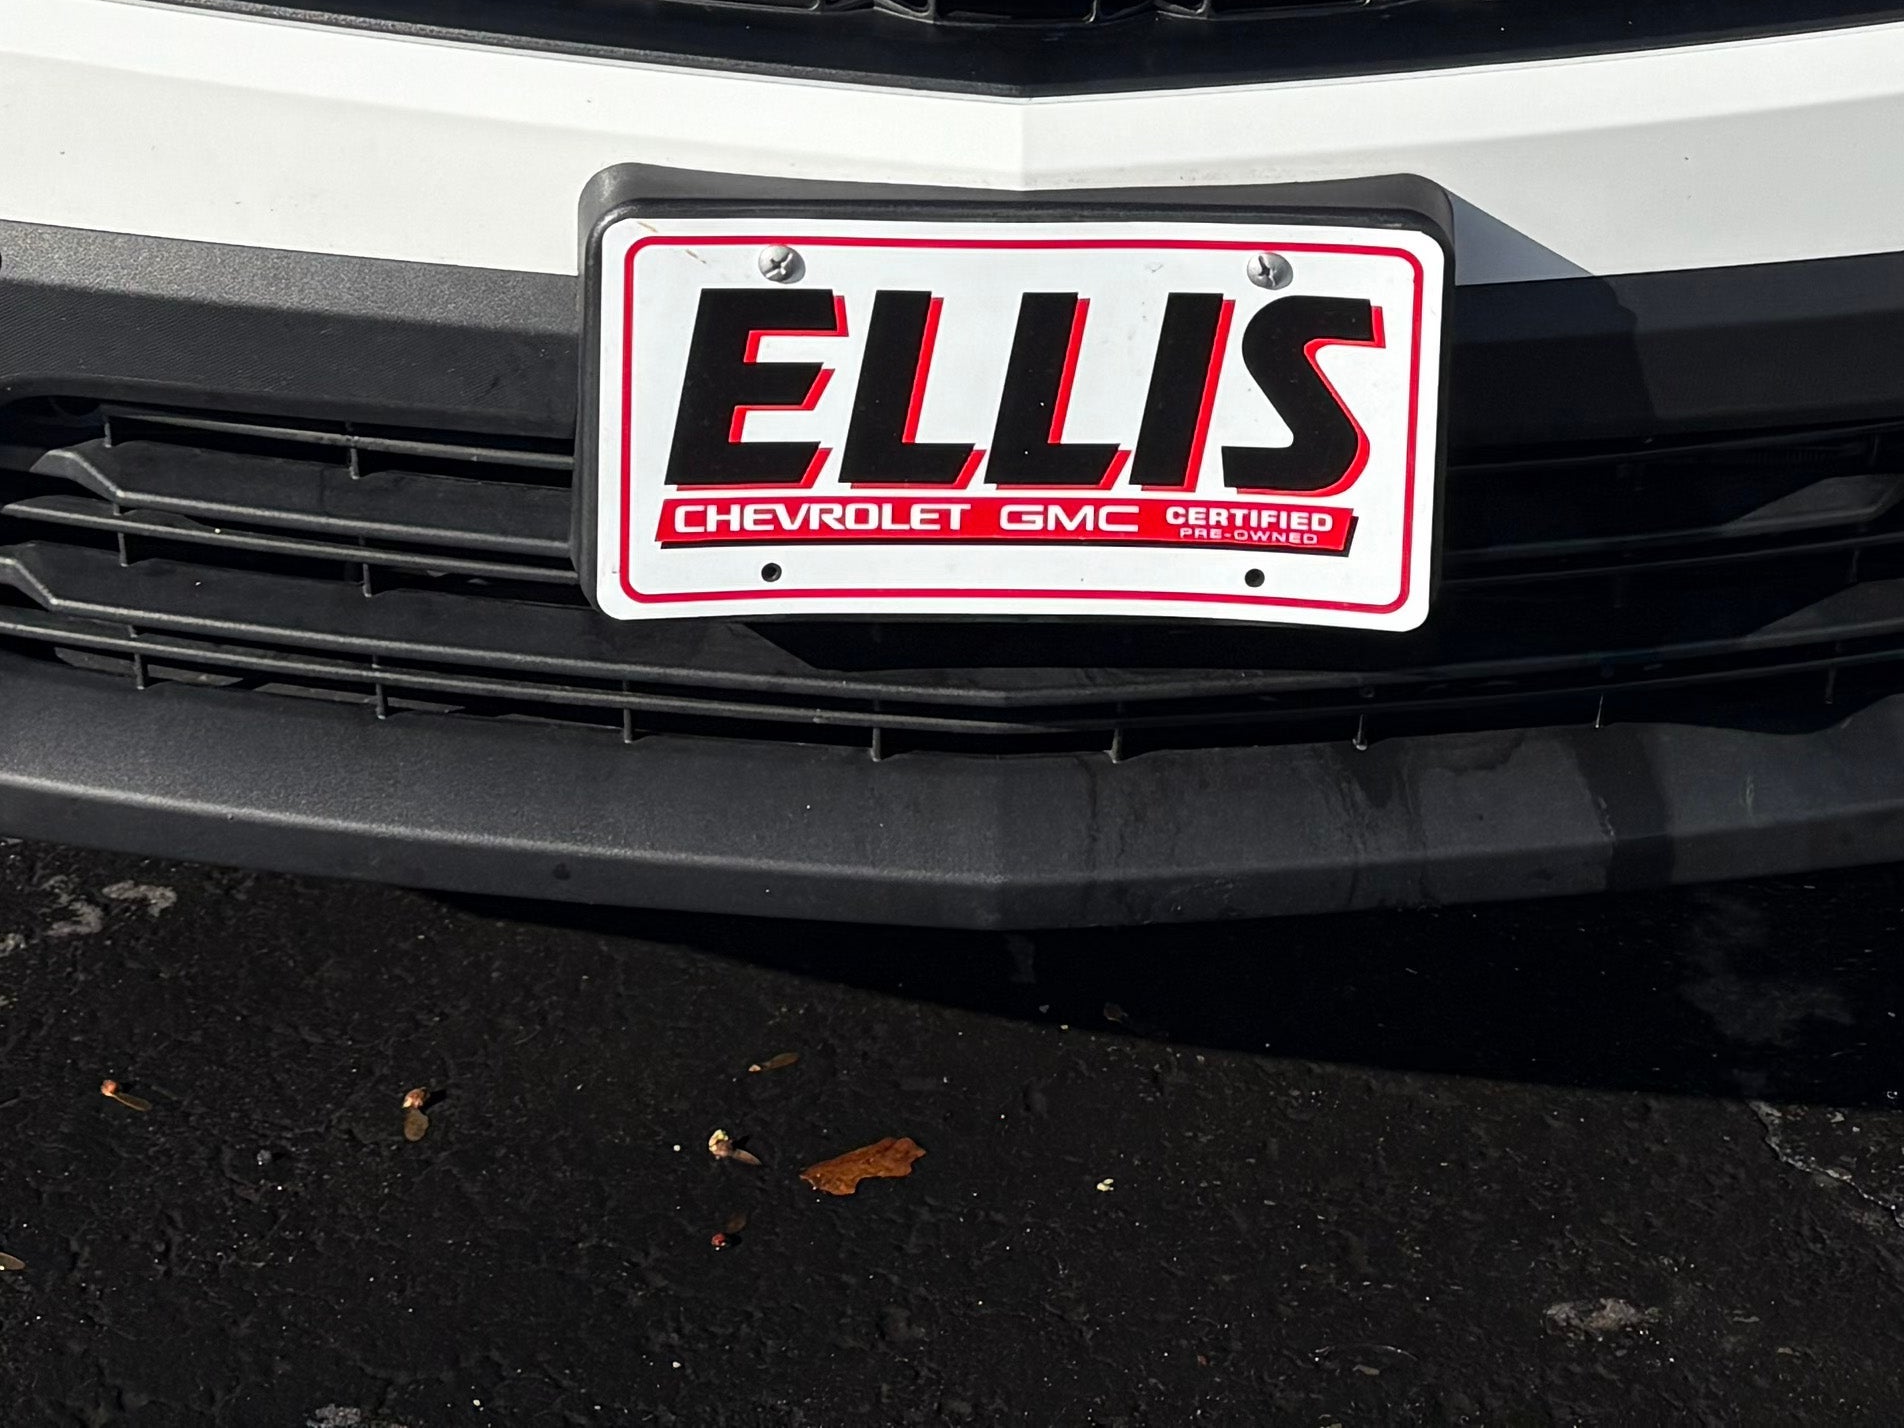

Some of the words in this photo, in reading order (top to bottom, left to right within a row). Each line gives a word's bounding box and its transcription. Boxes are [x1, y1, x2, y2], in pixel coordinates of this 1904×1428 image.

[665, 288, 1387, 497] ELLIS
[674, 502, 972, 533] CHEVROLET
[999, 504, 1140, 533] GMC
[1165, 506, 1334, 533] CERTIFIED
[1179, 527, 1318, 545] PRE-OWNED
